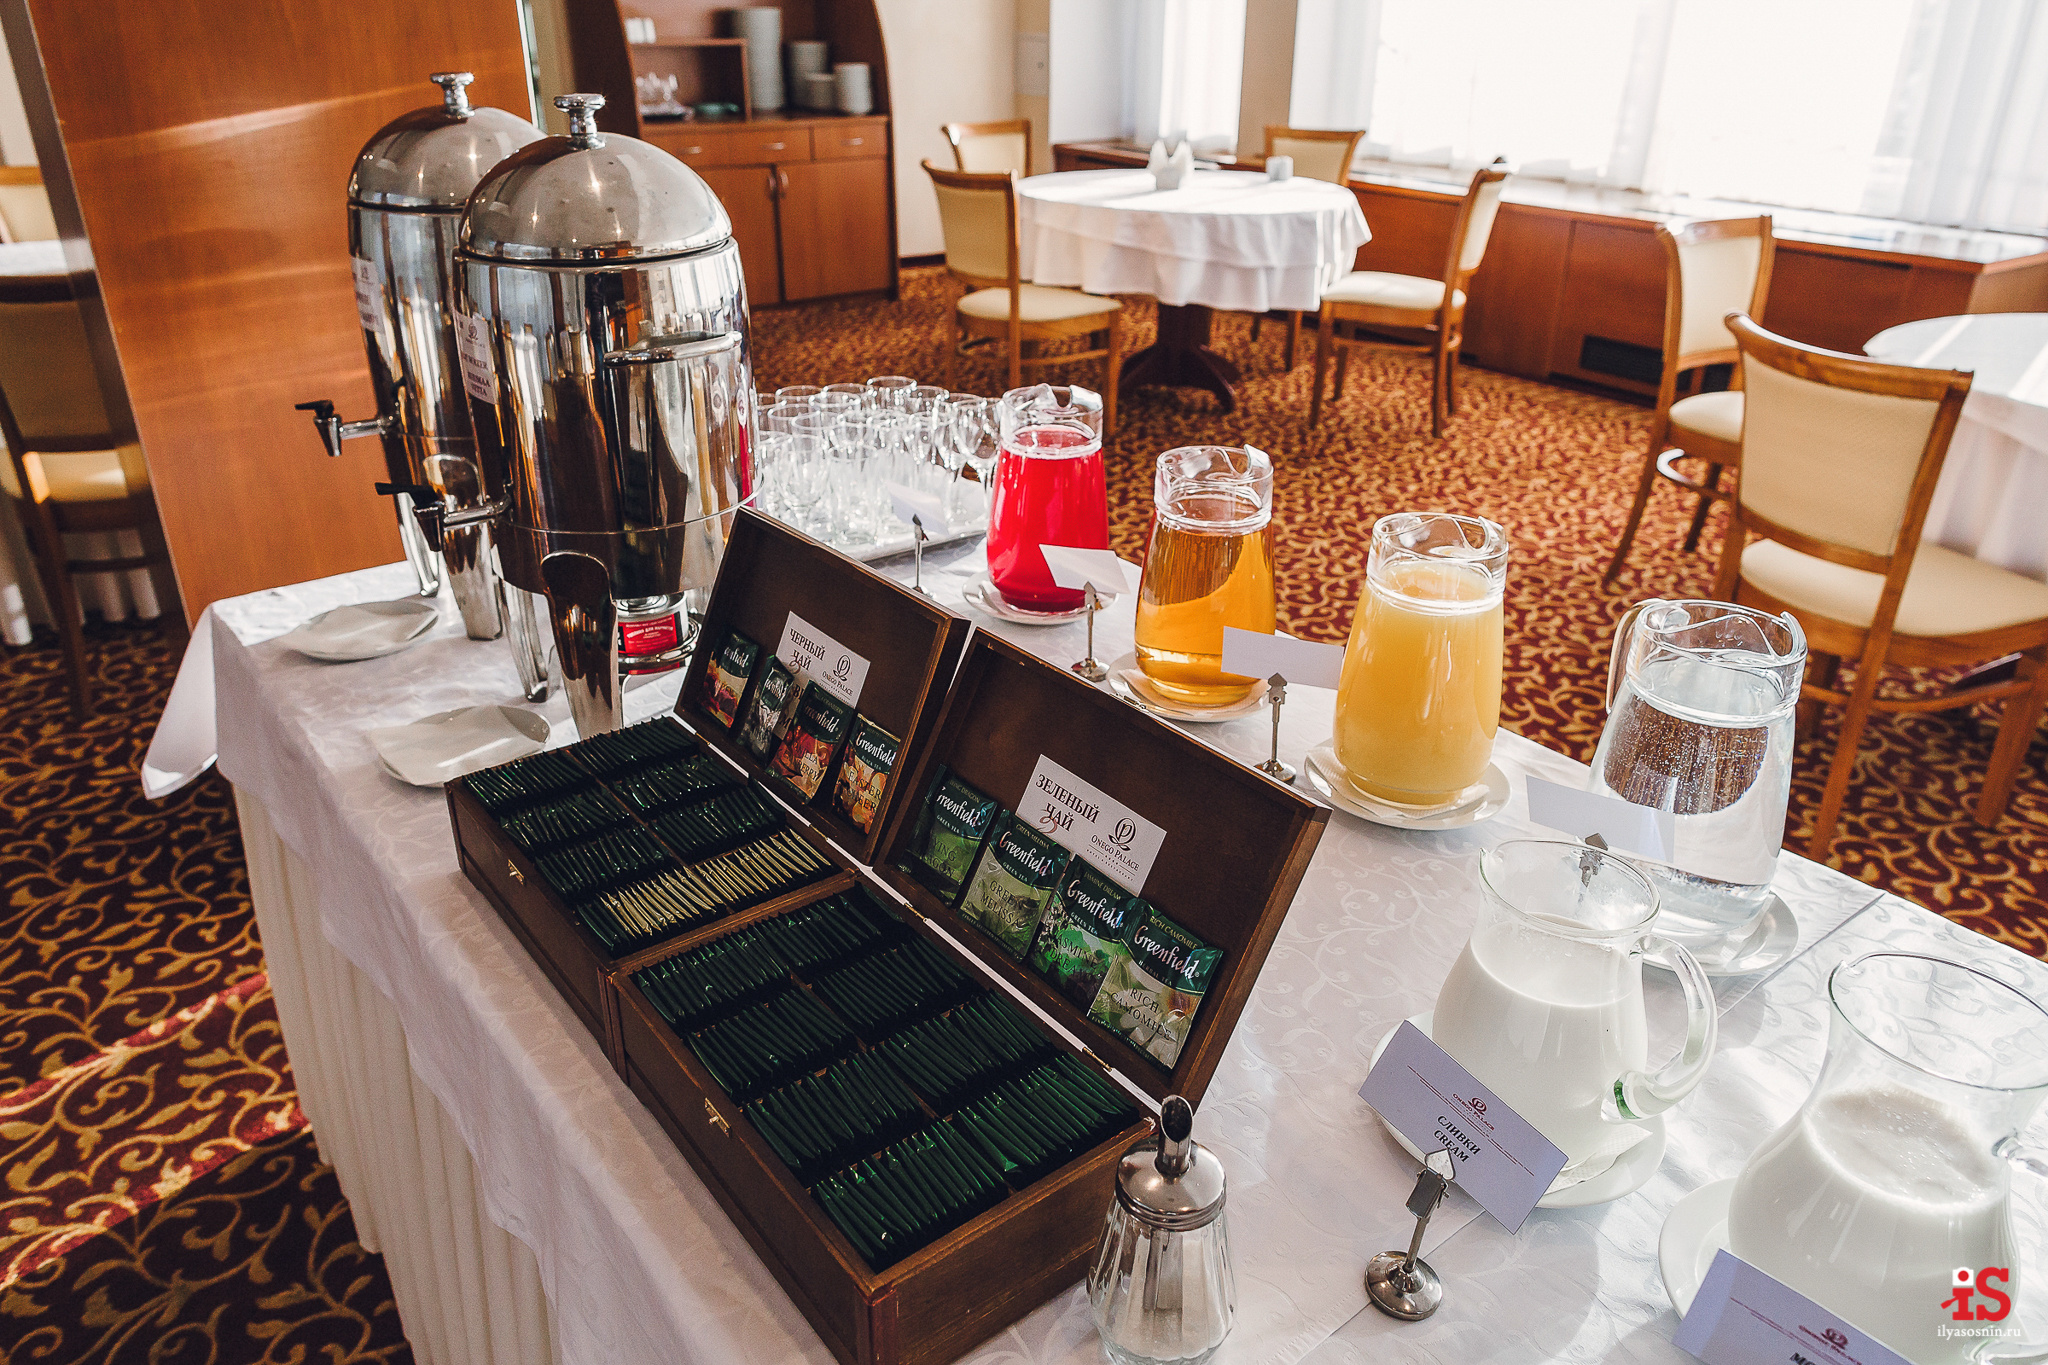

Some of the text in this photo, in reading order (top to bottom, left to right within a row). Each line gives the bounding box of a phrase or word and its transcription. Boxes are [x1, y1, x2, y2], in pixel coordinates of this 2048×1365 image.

[790, 628, 826, 661] ЧЕРНЫЙ
[792, 649, 812, 671] ЧАЙ
[822, 670, 838, 686] ONEGO
[836, 680, 854, 698] PALACE
[856, 731, 898, 768] Greenfield
[1035, 773, 1101, 825] ЗЕЛЕНЫЙ
[936, 814, 961, 834] GREEN TEA
[1045, 802, 1076, 832] ЧАЙ
[999, 830, 1054, 877] Greenfield
[1091, 834, 1141, 873] ONEGO PALACE
[1002, 860, 1029, 883] GREEN TEA
[980, 891, 1024, 928] MELISSA
[1067, 878, 1125, 930] Greenfield
[1102, 885, 1122, 901] DREAM
[1070, 911, 1099, 936] GREEN TEA
[1149, 916, 1199, 951] RICH CAMOMILE
[1133, 924, 1200, 982] Greenfield
[1160, 976, 1173, 988] TEA
[1110, 992, 1173, 1042] CAMOMILE
[1129, 987, 1161, 1014] RICH
[1437, 1115, 1481, 1155] СЛИВКИ
[1473, 1110, 1495, 1131] PALACE
[1433, 1130, 1470, 1163] CREAM
